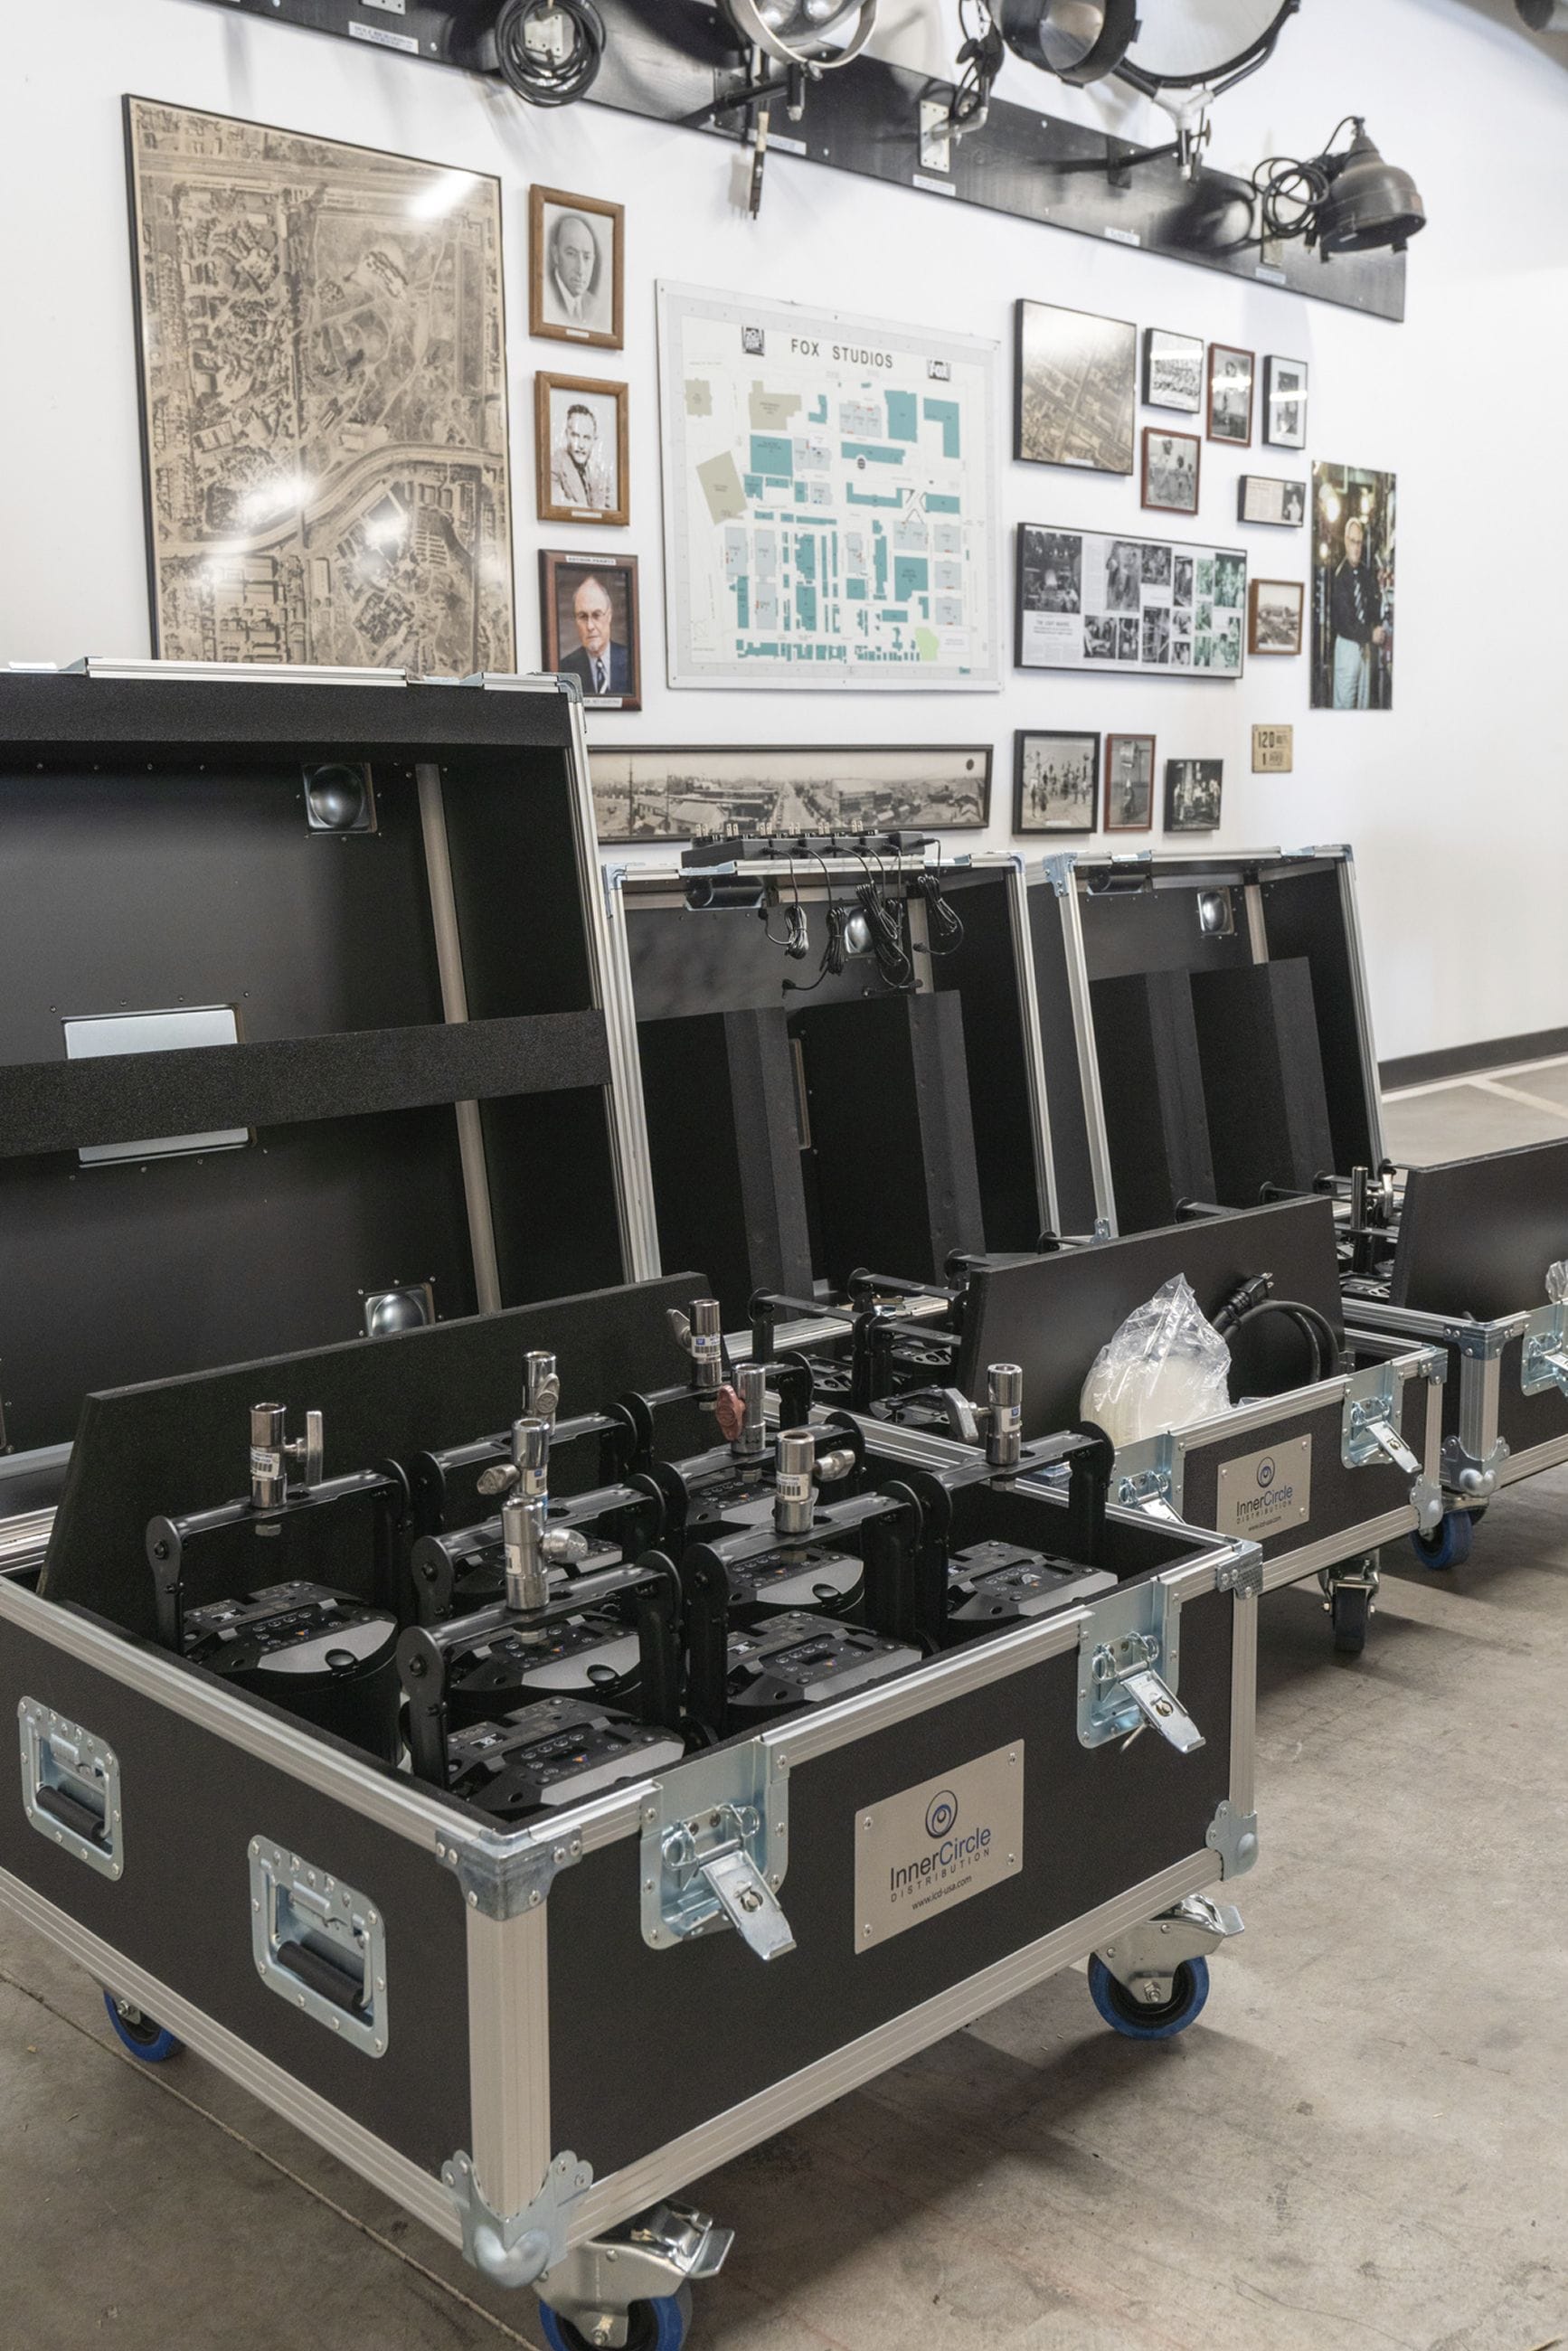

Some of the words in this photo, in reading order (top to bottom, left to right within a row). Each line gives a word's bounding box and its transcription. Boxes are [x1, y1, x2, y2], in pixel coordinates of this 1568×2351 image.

[790, 338, 820, 357] FOX
[832, 345, 893, 369] STUDIOS
[1258, 731, 1275, 749] 120
[1236, 1485, 1293, 1517] InnerCircle
[890, 1827, 991, 1892] InnerCircle
[890, 1847, 990, 1903] DISTRIBUTION
